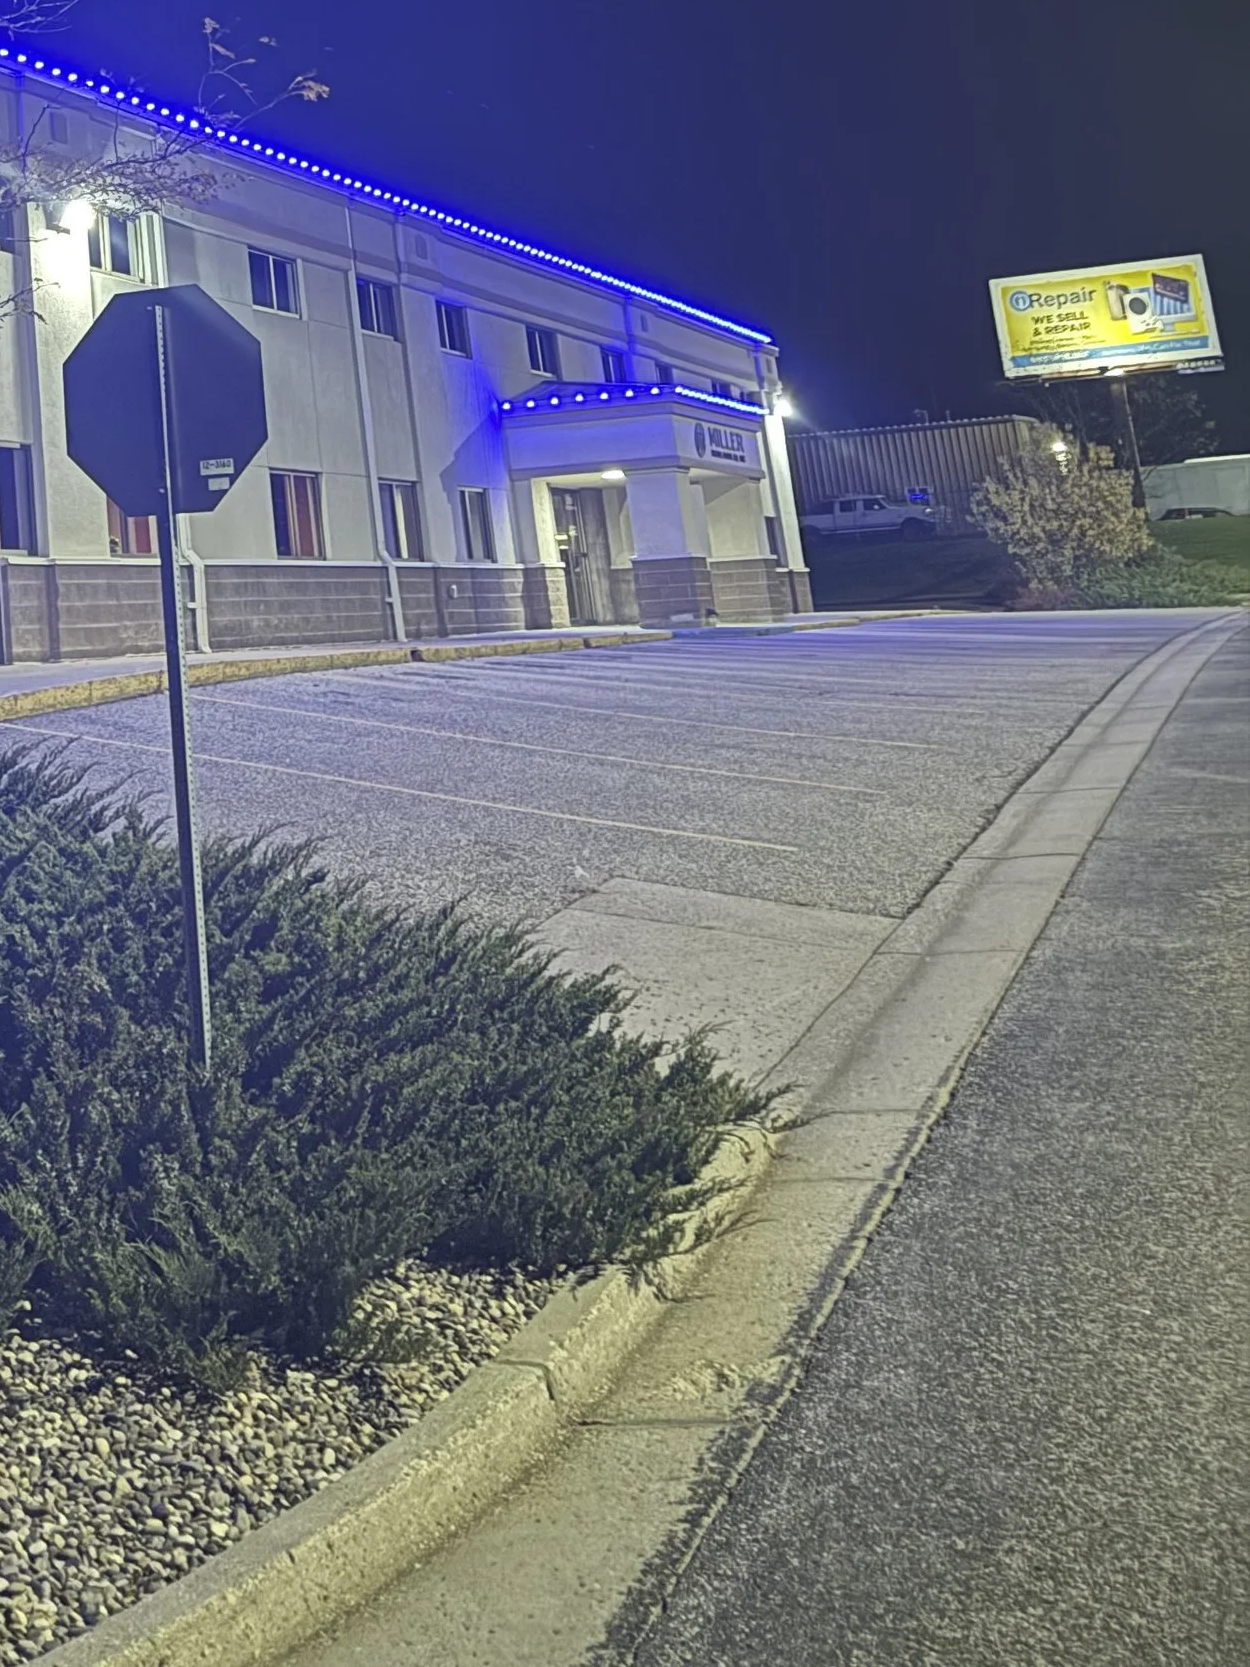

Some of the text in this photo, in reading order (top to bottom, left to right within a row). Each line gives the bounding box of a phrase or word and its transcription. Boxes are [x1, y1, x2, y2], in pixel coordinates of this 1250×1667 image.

[1031, 311, 1088, 325] WE SELL
[1033, 322, 1091, 337] & REPAIR
[707, 427, 745, 453] MILLER
